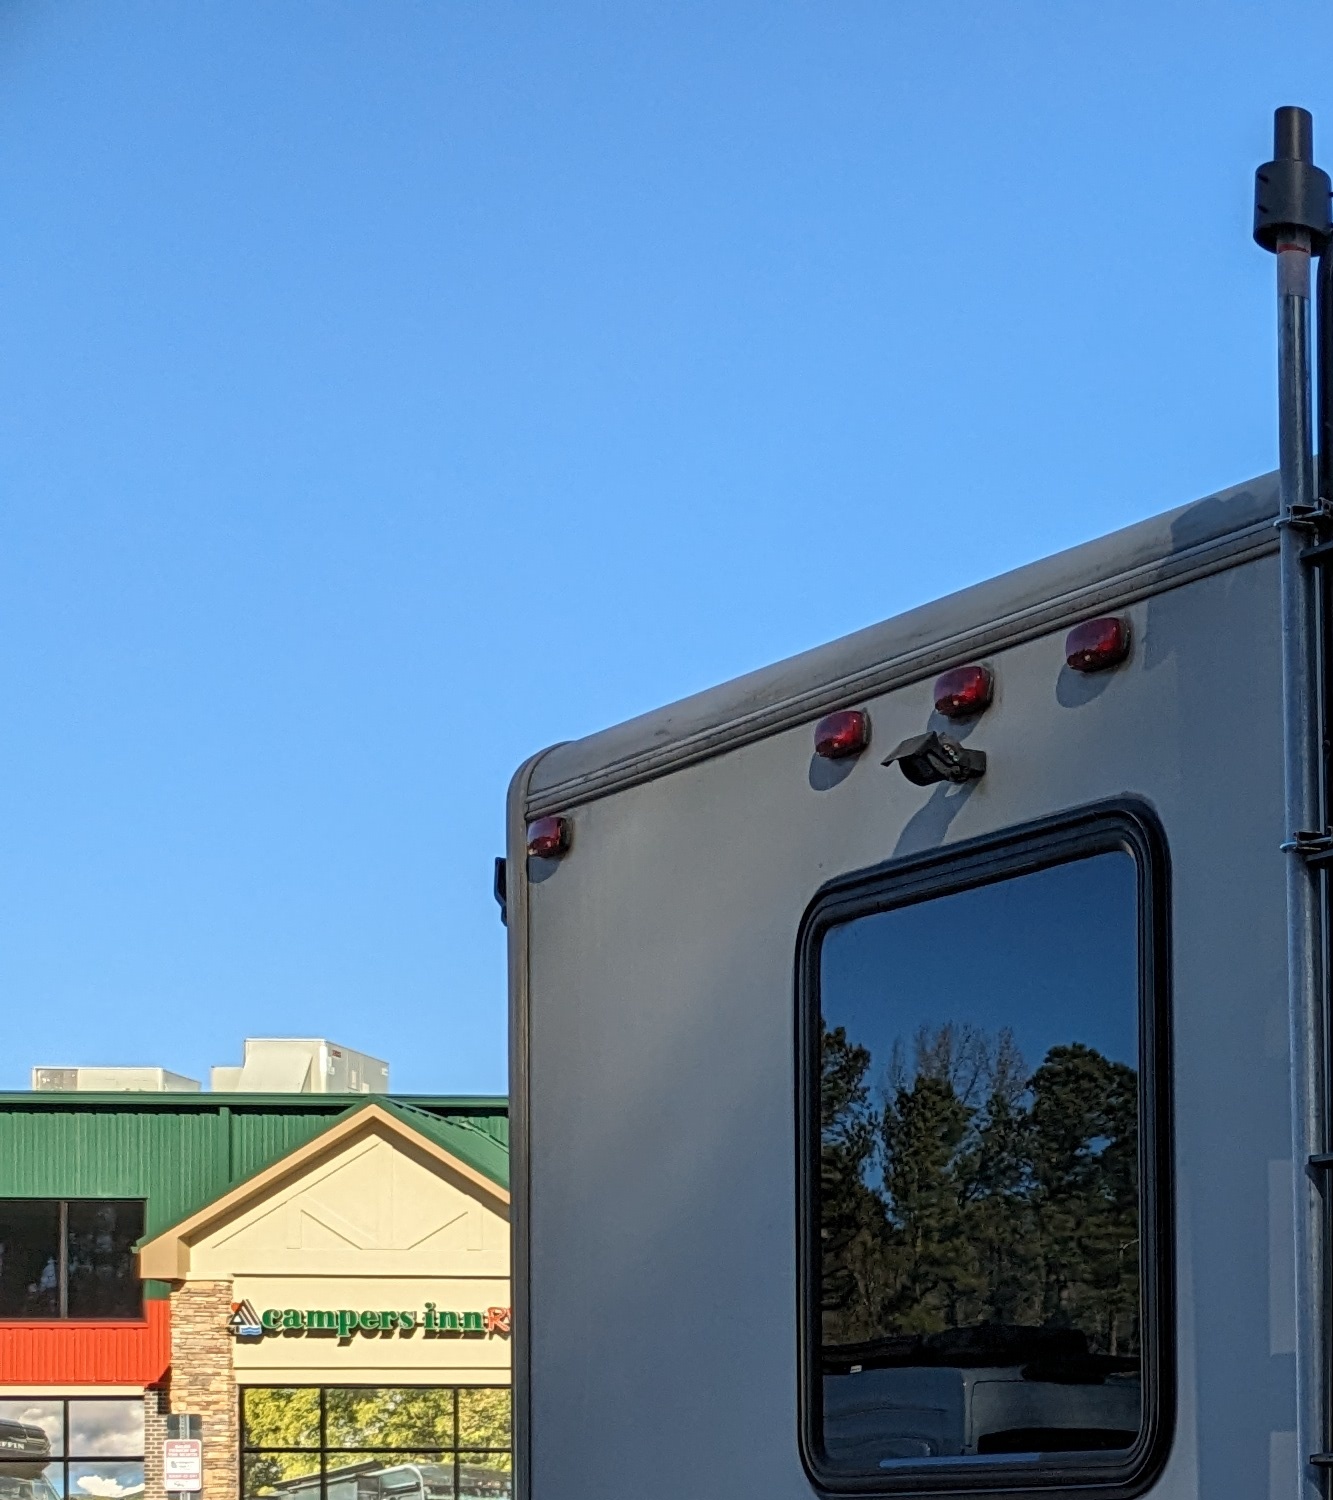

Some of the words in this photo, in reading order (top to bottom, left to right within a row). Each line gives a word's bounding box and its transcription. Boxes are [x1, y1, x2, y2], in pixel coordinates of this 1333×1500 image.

[261, 1307, 416, 1338] campers
[423, 1302, 486, 1331] inn
[486, 1306, 511, 1332] R
